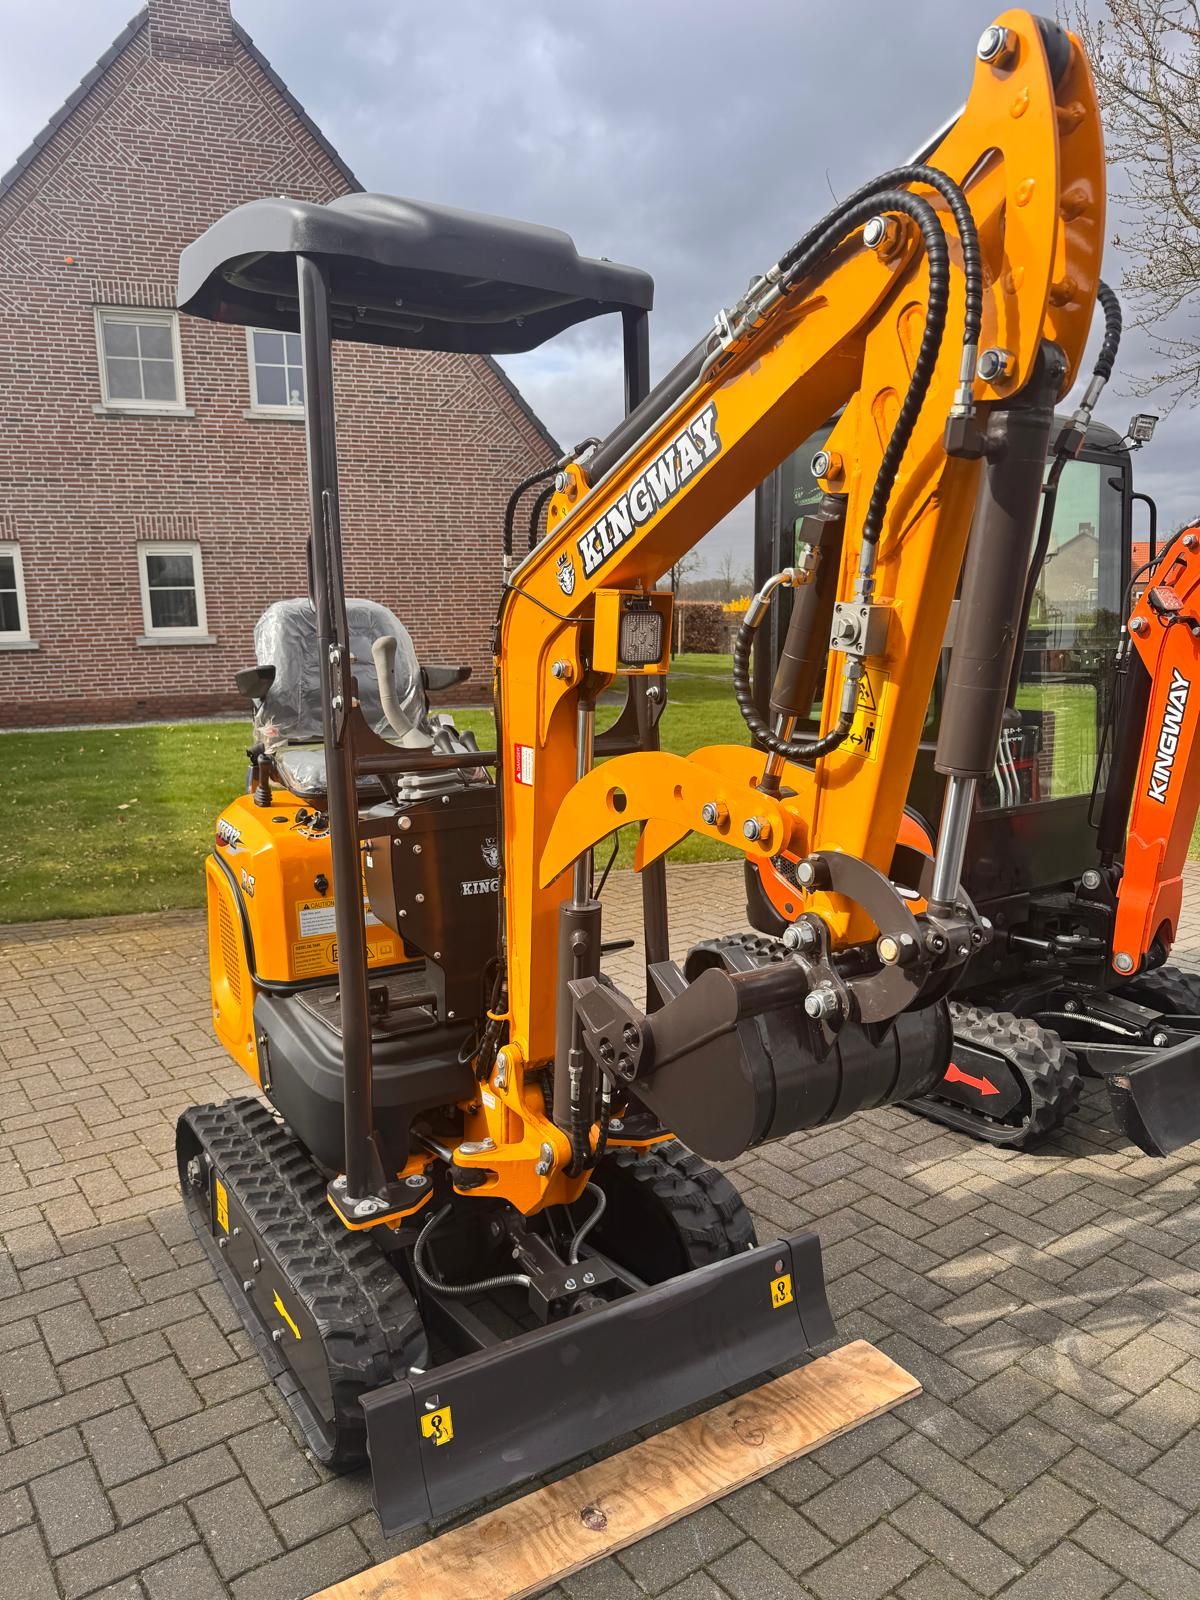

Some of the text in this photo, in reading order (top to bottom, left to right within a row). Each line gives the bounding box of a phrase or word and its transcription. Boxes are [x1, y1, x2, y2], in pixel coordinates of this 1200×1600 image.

[577, 402, 721, 579] KINGWAY
[1148, 668, 1190, 803] KINGWAY
[310, 900, 335, 909] CAUTION
